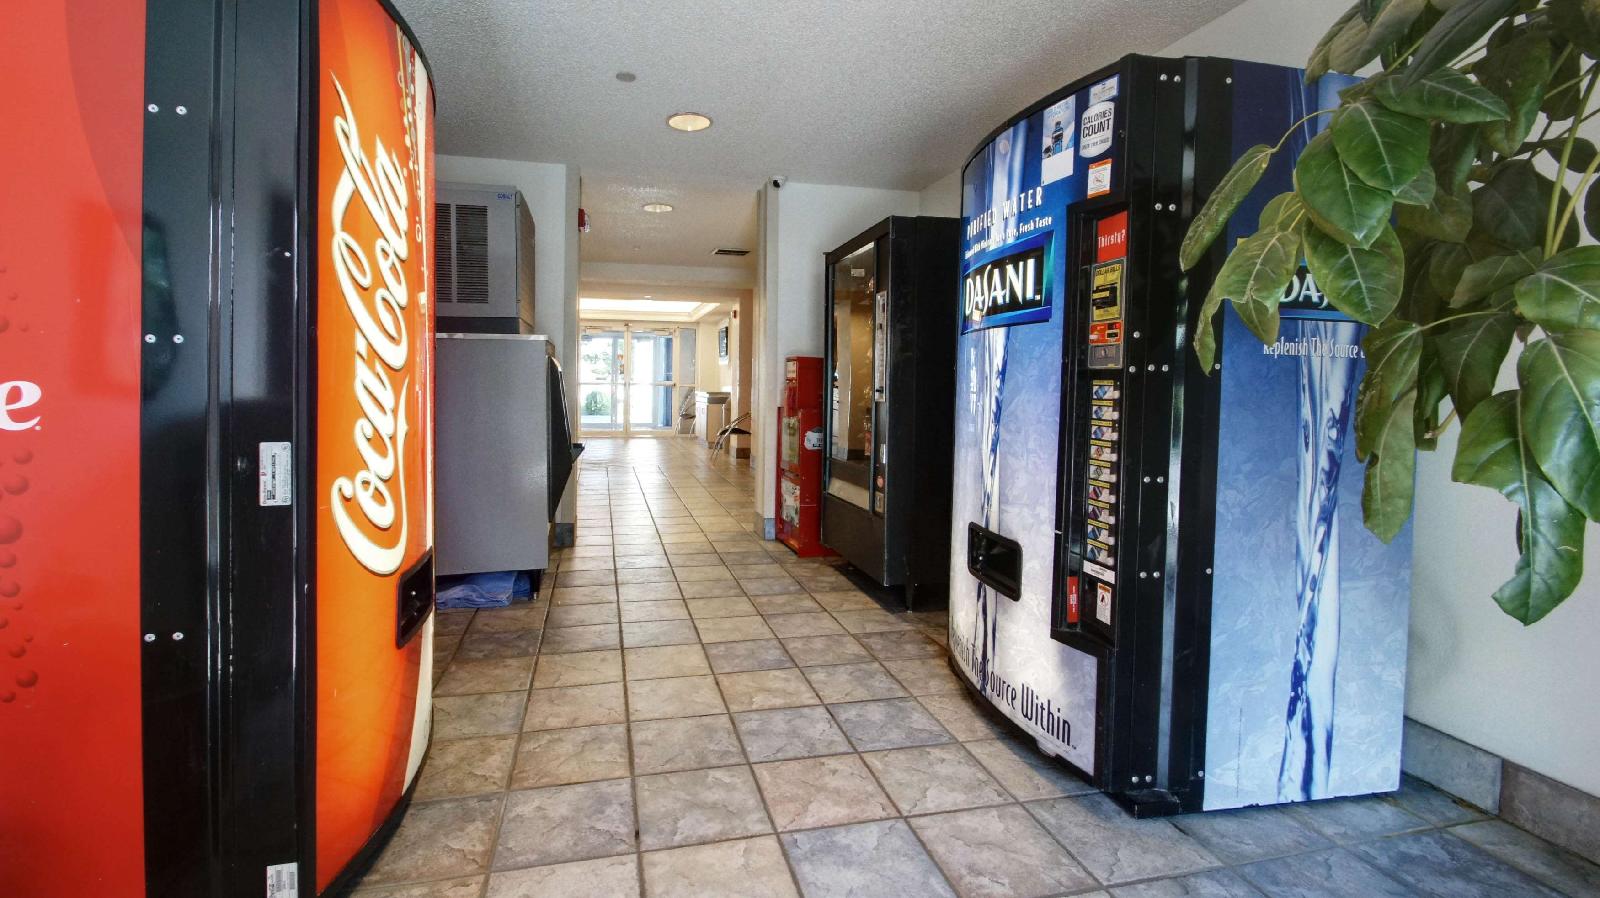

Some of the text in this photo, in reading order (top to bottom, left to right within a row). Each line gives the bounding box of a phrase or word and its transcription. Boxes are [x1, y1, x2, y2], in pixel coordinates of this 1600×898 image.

[1082, 118, 1112, 139] COUNT
[1002, 186, 1043, 221] WATER
[1019, 219, 1035, 235] Fresh
[1035, 216, 1052, 229] Taste
[1098, 229, 1126, 249] Thirsty?
[965, 258, 1036, 317] DASANI
[329, 69, 410, 577] Coca-Cola
[1311, 337, 1327, 358] The
[1329, 339, 1358, 359] Source
[984, 658, 1017, 711] Source
[1021, 683, 1071, 746] Within
